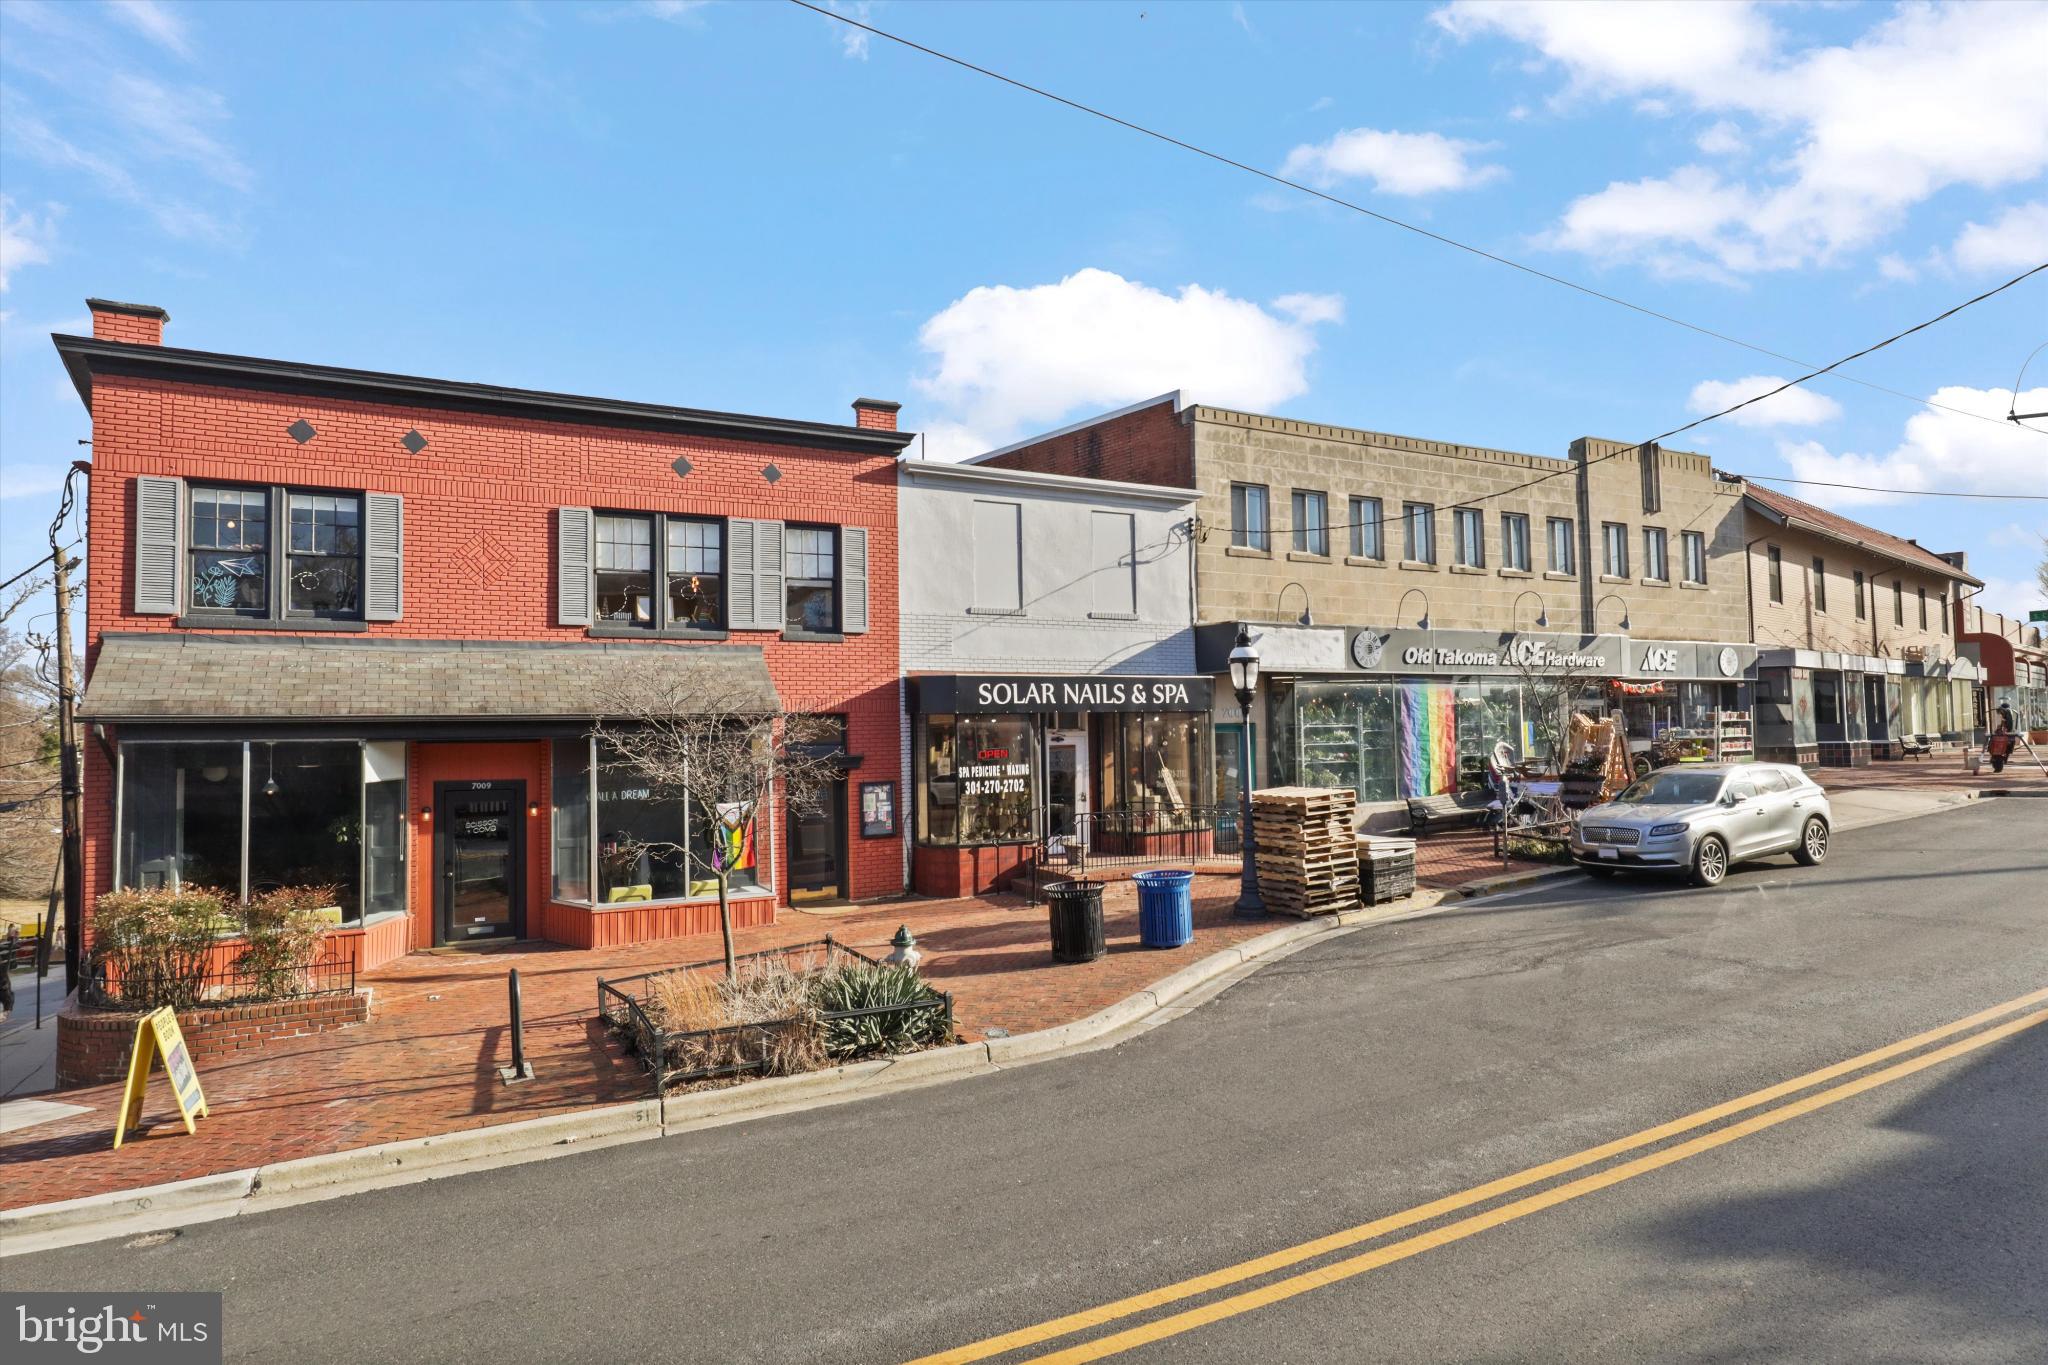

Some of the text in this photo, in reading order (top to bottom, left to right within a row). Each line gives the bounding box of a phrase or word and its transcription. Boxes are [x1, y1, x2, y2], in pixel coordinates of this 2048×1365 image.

[1404, 636, 1606, 667] Old Takoma ACE Hardware
[1640, 645, 1678, 671] ACE
[978, 683, 1189, 705] SOLAR NAILS & SPA
[978, 749, 1009, 760] OPEN
[959, 763, 1029, 778] SPA PEDICURE WAXING
[471, 782, 492, 790] 7009
[965, 779, 1024, 795] 301-270-2702
[621, 789, 650, 800] DREAM
